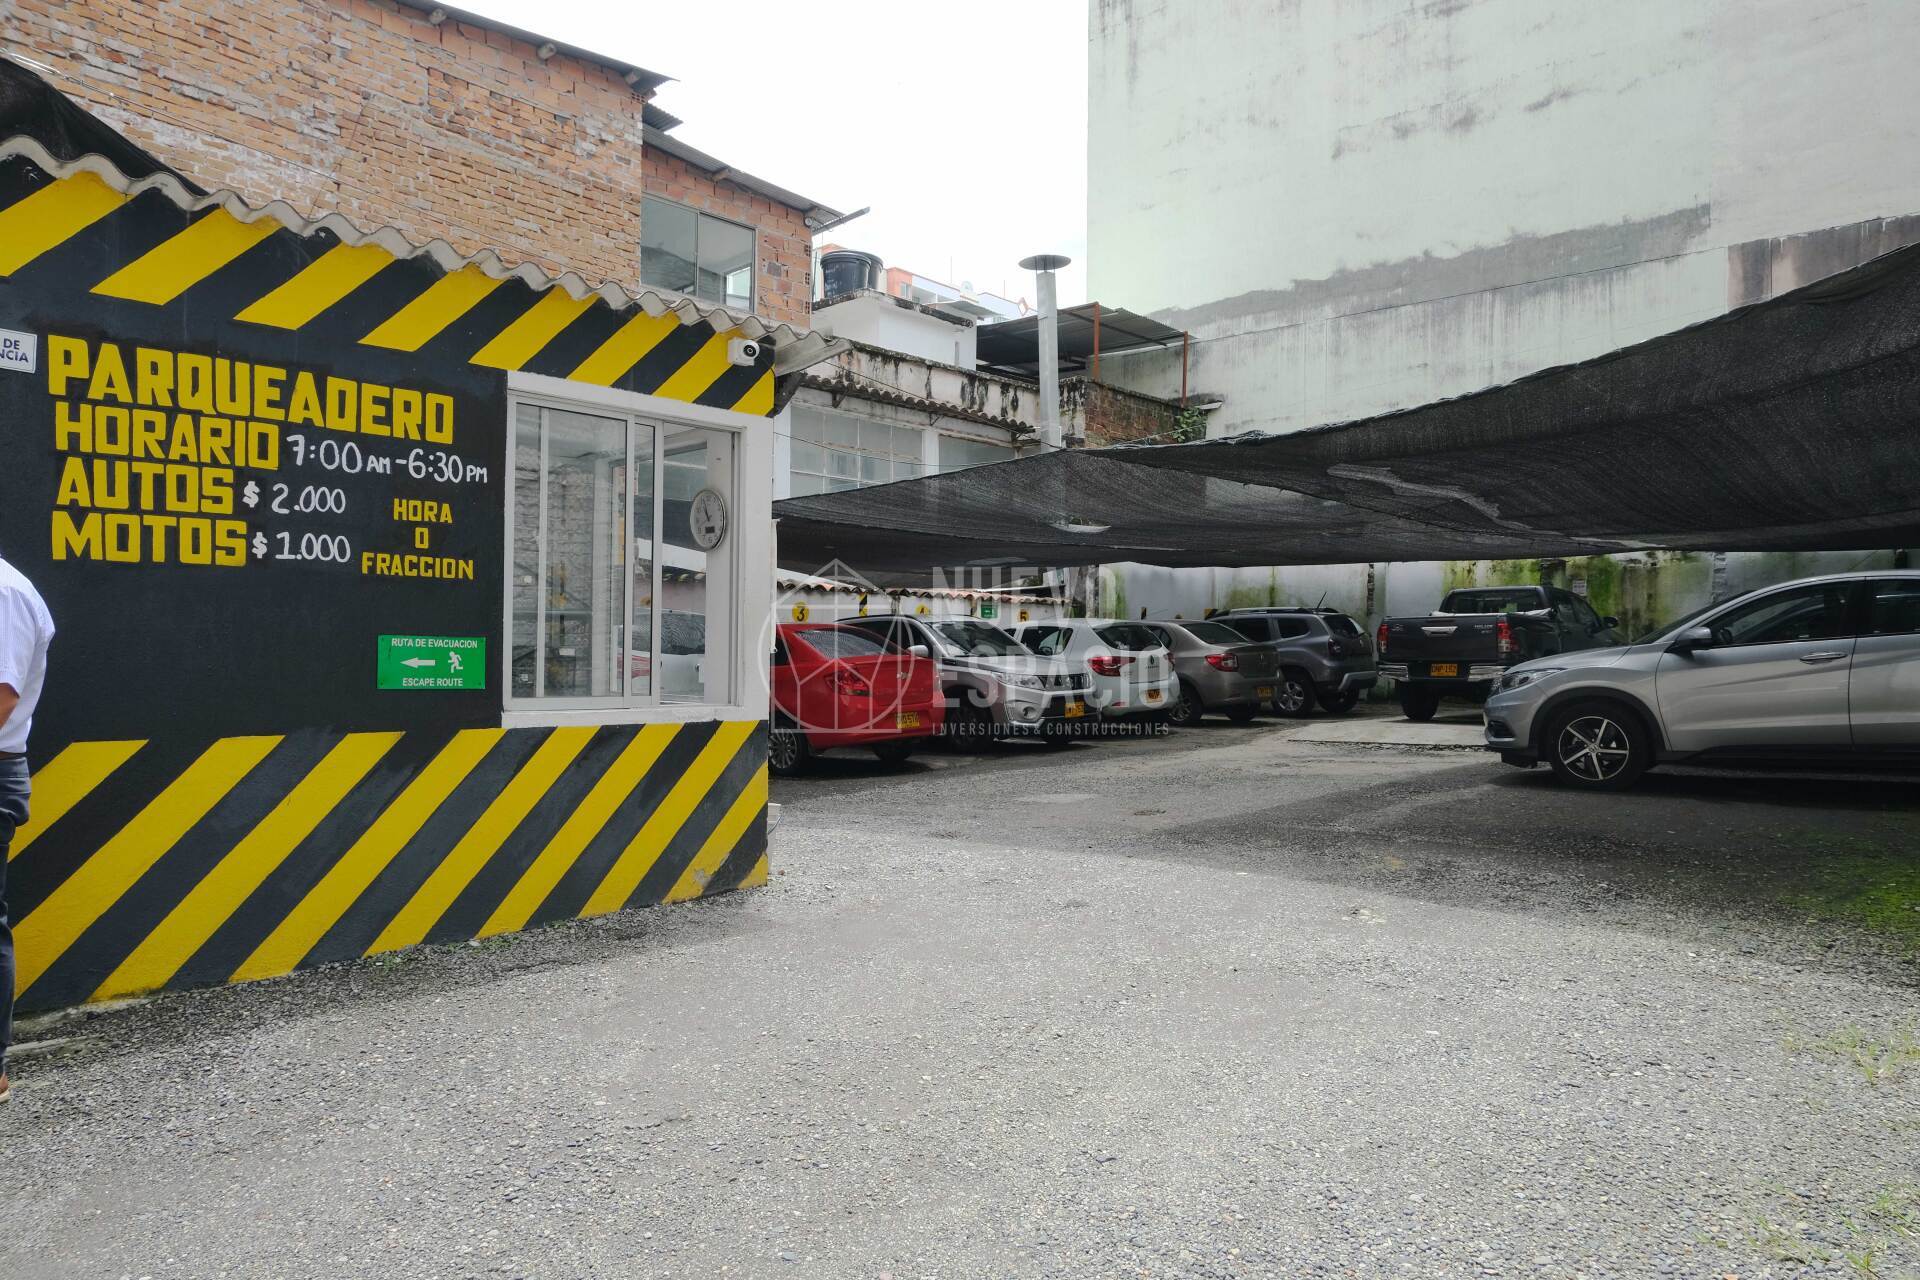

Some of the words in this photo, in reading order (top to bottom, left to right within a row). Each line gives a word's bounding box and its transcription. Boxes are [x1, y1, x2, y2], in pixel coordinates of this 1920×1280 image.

[3, 337, 21, 350] DE
[47, 334, 454, 445] PARQUEADERO
[55, 401, 279, 471] HORARIO
[286, 434, 363, 474] 7:00
[366, 455, 392, 475] AM
[466, 465, 488, 484] PM
[56, 456, 234, 515] AUTOS
[393, 498, 453, 524] HORA
[51, 510, 247, 567] MOTOS
[361, 551, 474, 580] FRACCION
[391, 638, 414, 647] RUTA
[415, 638, 426, 647] DE
[428, 639, 478, 649] EVACUACION
[402, 677, 435, 687] ESCAPE
[436, 678, 463, 687] ROUTE
